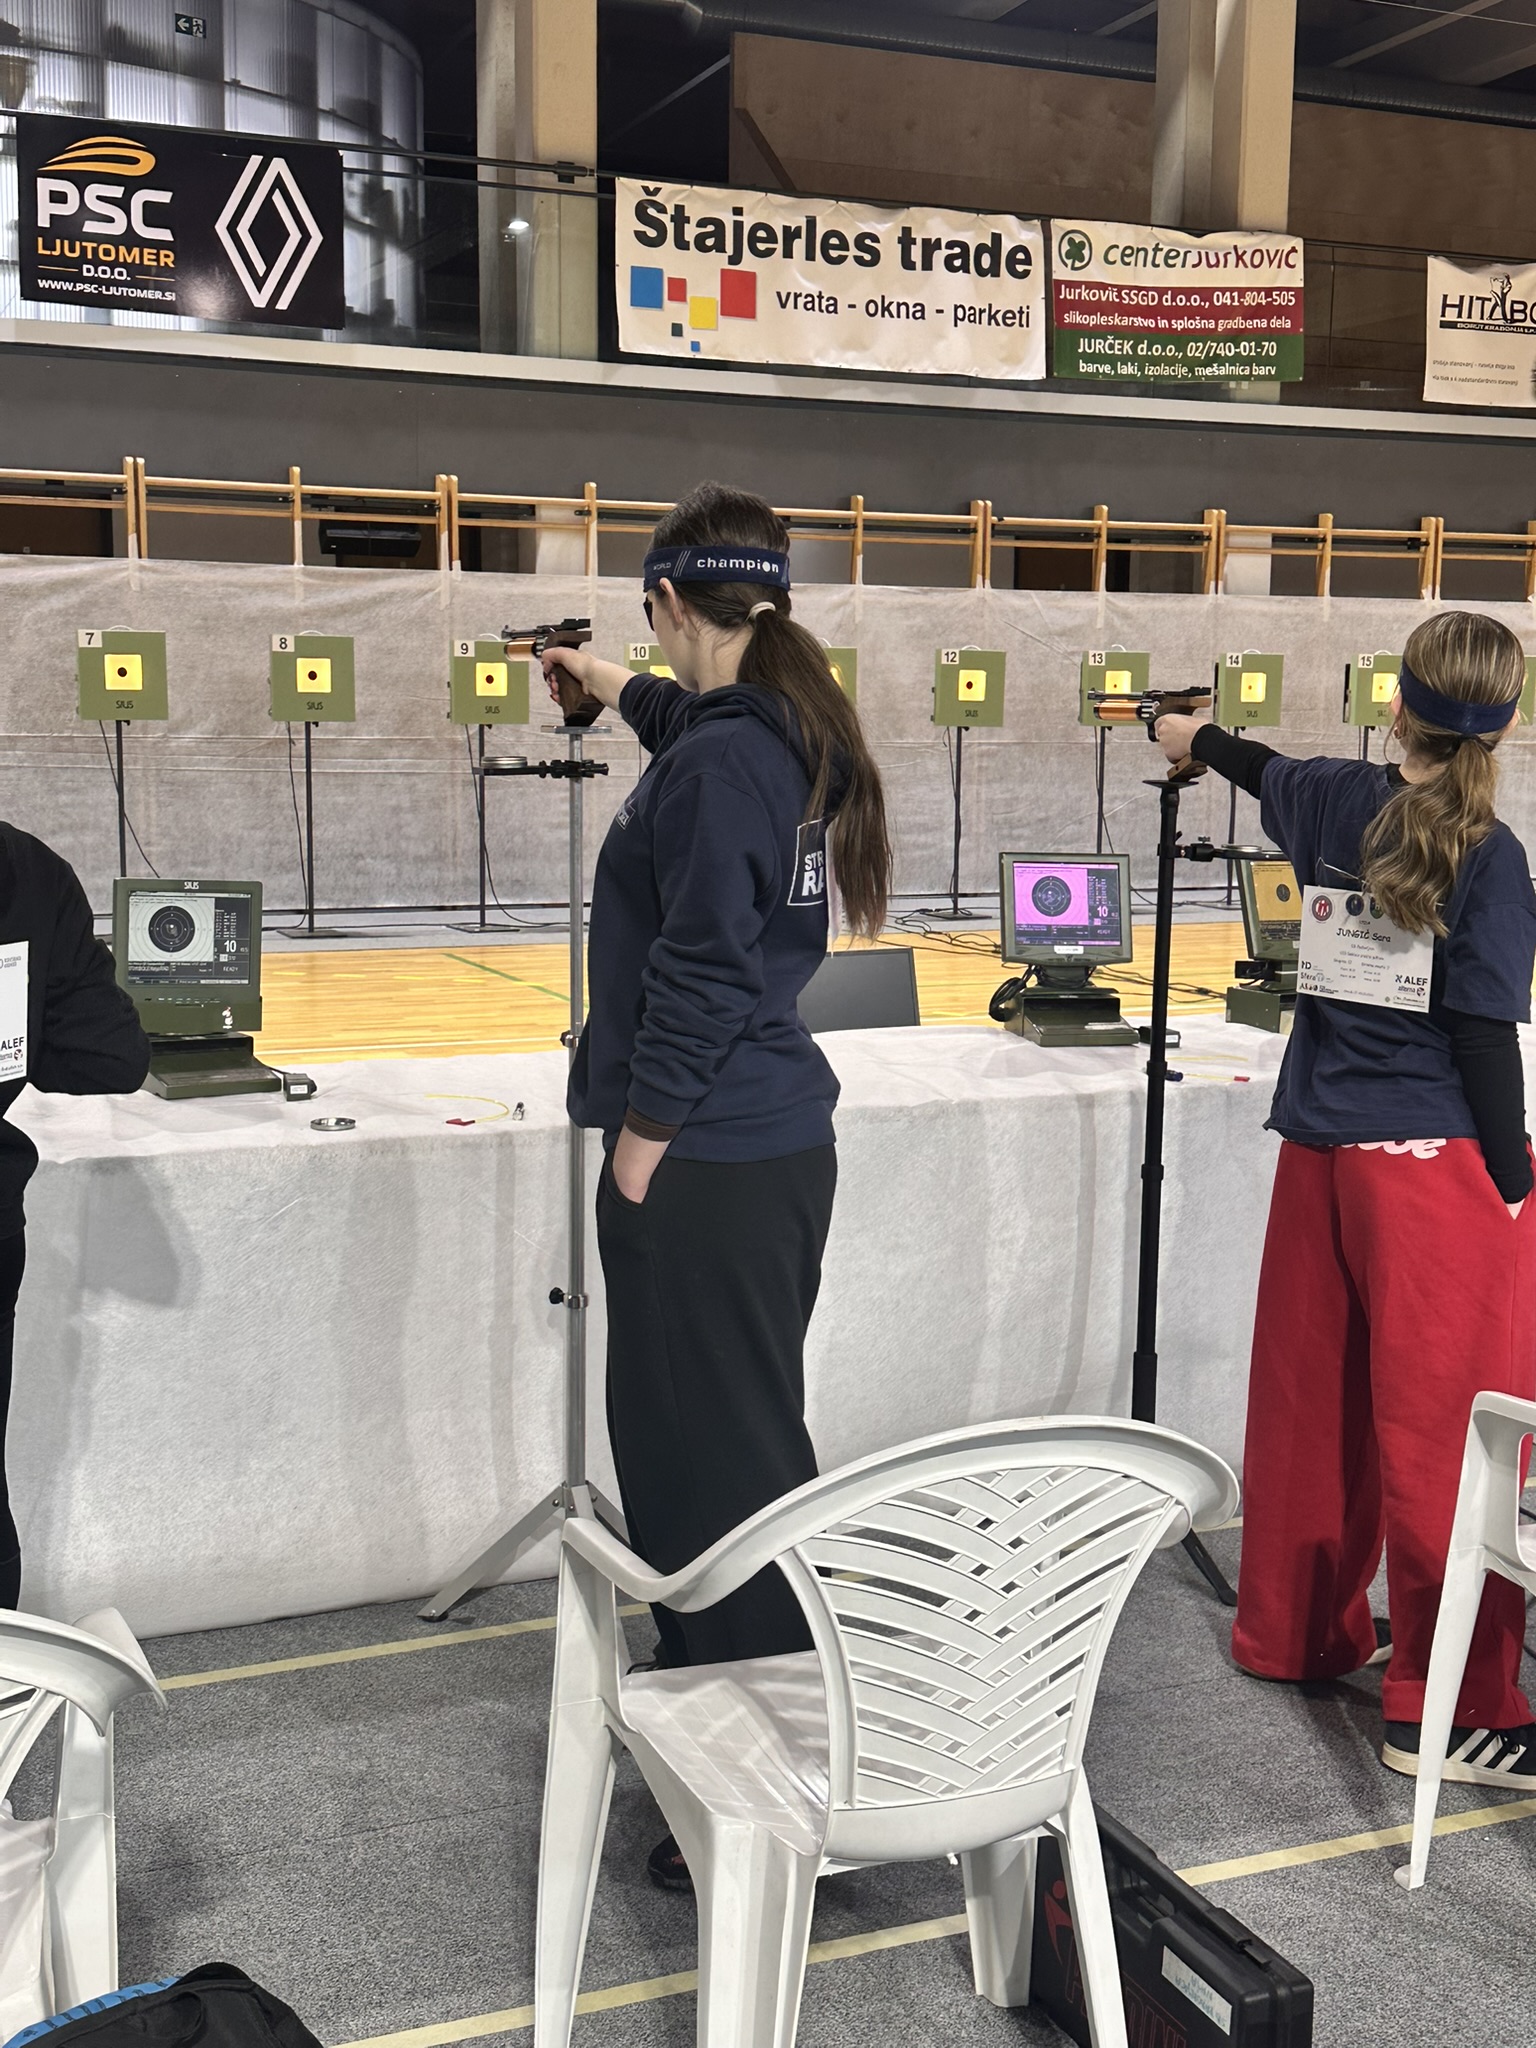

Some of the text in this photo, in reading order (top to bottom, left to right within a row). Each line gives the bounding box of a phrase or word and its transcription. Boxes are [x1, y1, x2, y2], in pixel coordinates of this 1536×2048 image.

[37, 178, 174, 241] PSC
[633, 185, 1032, 279] Štajerles trade
[37, 237, 175, 268] LJUTOMER
[82, 264, 131, 280] D.O.O.
[37, 279, 176, 301] WWW.PSC-LJUTOMER.SI
[1059, 284, 1296, 308] Jurkovič SSGD d.o.o., 041-804-505
[776, 290, 839, 314] vrata
[865, 295, 926, 320] okna
[953, 303, 1030, 328] parketi
[1063, 310, 1291, 331] slikopleskarstvo in splošna gradbena dela
[1078, 335, 1277, 360] JURČEK d.o.o., 02/740-01-70
[1079, 359, 1276, 378] barve, laki, izolacije, mešalnica barv
[697, 556, 779, 574] champion
[85, 632, 95, 646] 7
[279, 637, 288, 650] 8
[460, 642, 469, 655] 9
[632, 646, 647, 659] 10
[944, 651, 957, 663] 12
[1091, 653, 1104, 664] 13
[1228, 655, 1240, 666] 14
[1361, 656, 1373, 667] 15
[115, 700, 134, 710] SIUS
[306, 701, 324, 711] SIUS
[484, 705, 500, 715] SIUS
[184, 881, 199, 890] SIUS
[1097, 905, 1109, 918] 10
[224, 939, 237, 953] 10
[1404, 975, 1429, 987] ALEF
[0, 1036, 25, 1052] ALEF
